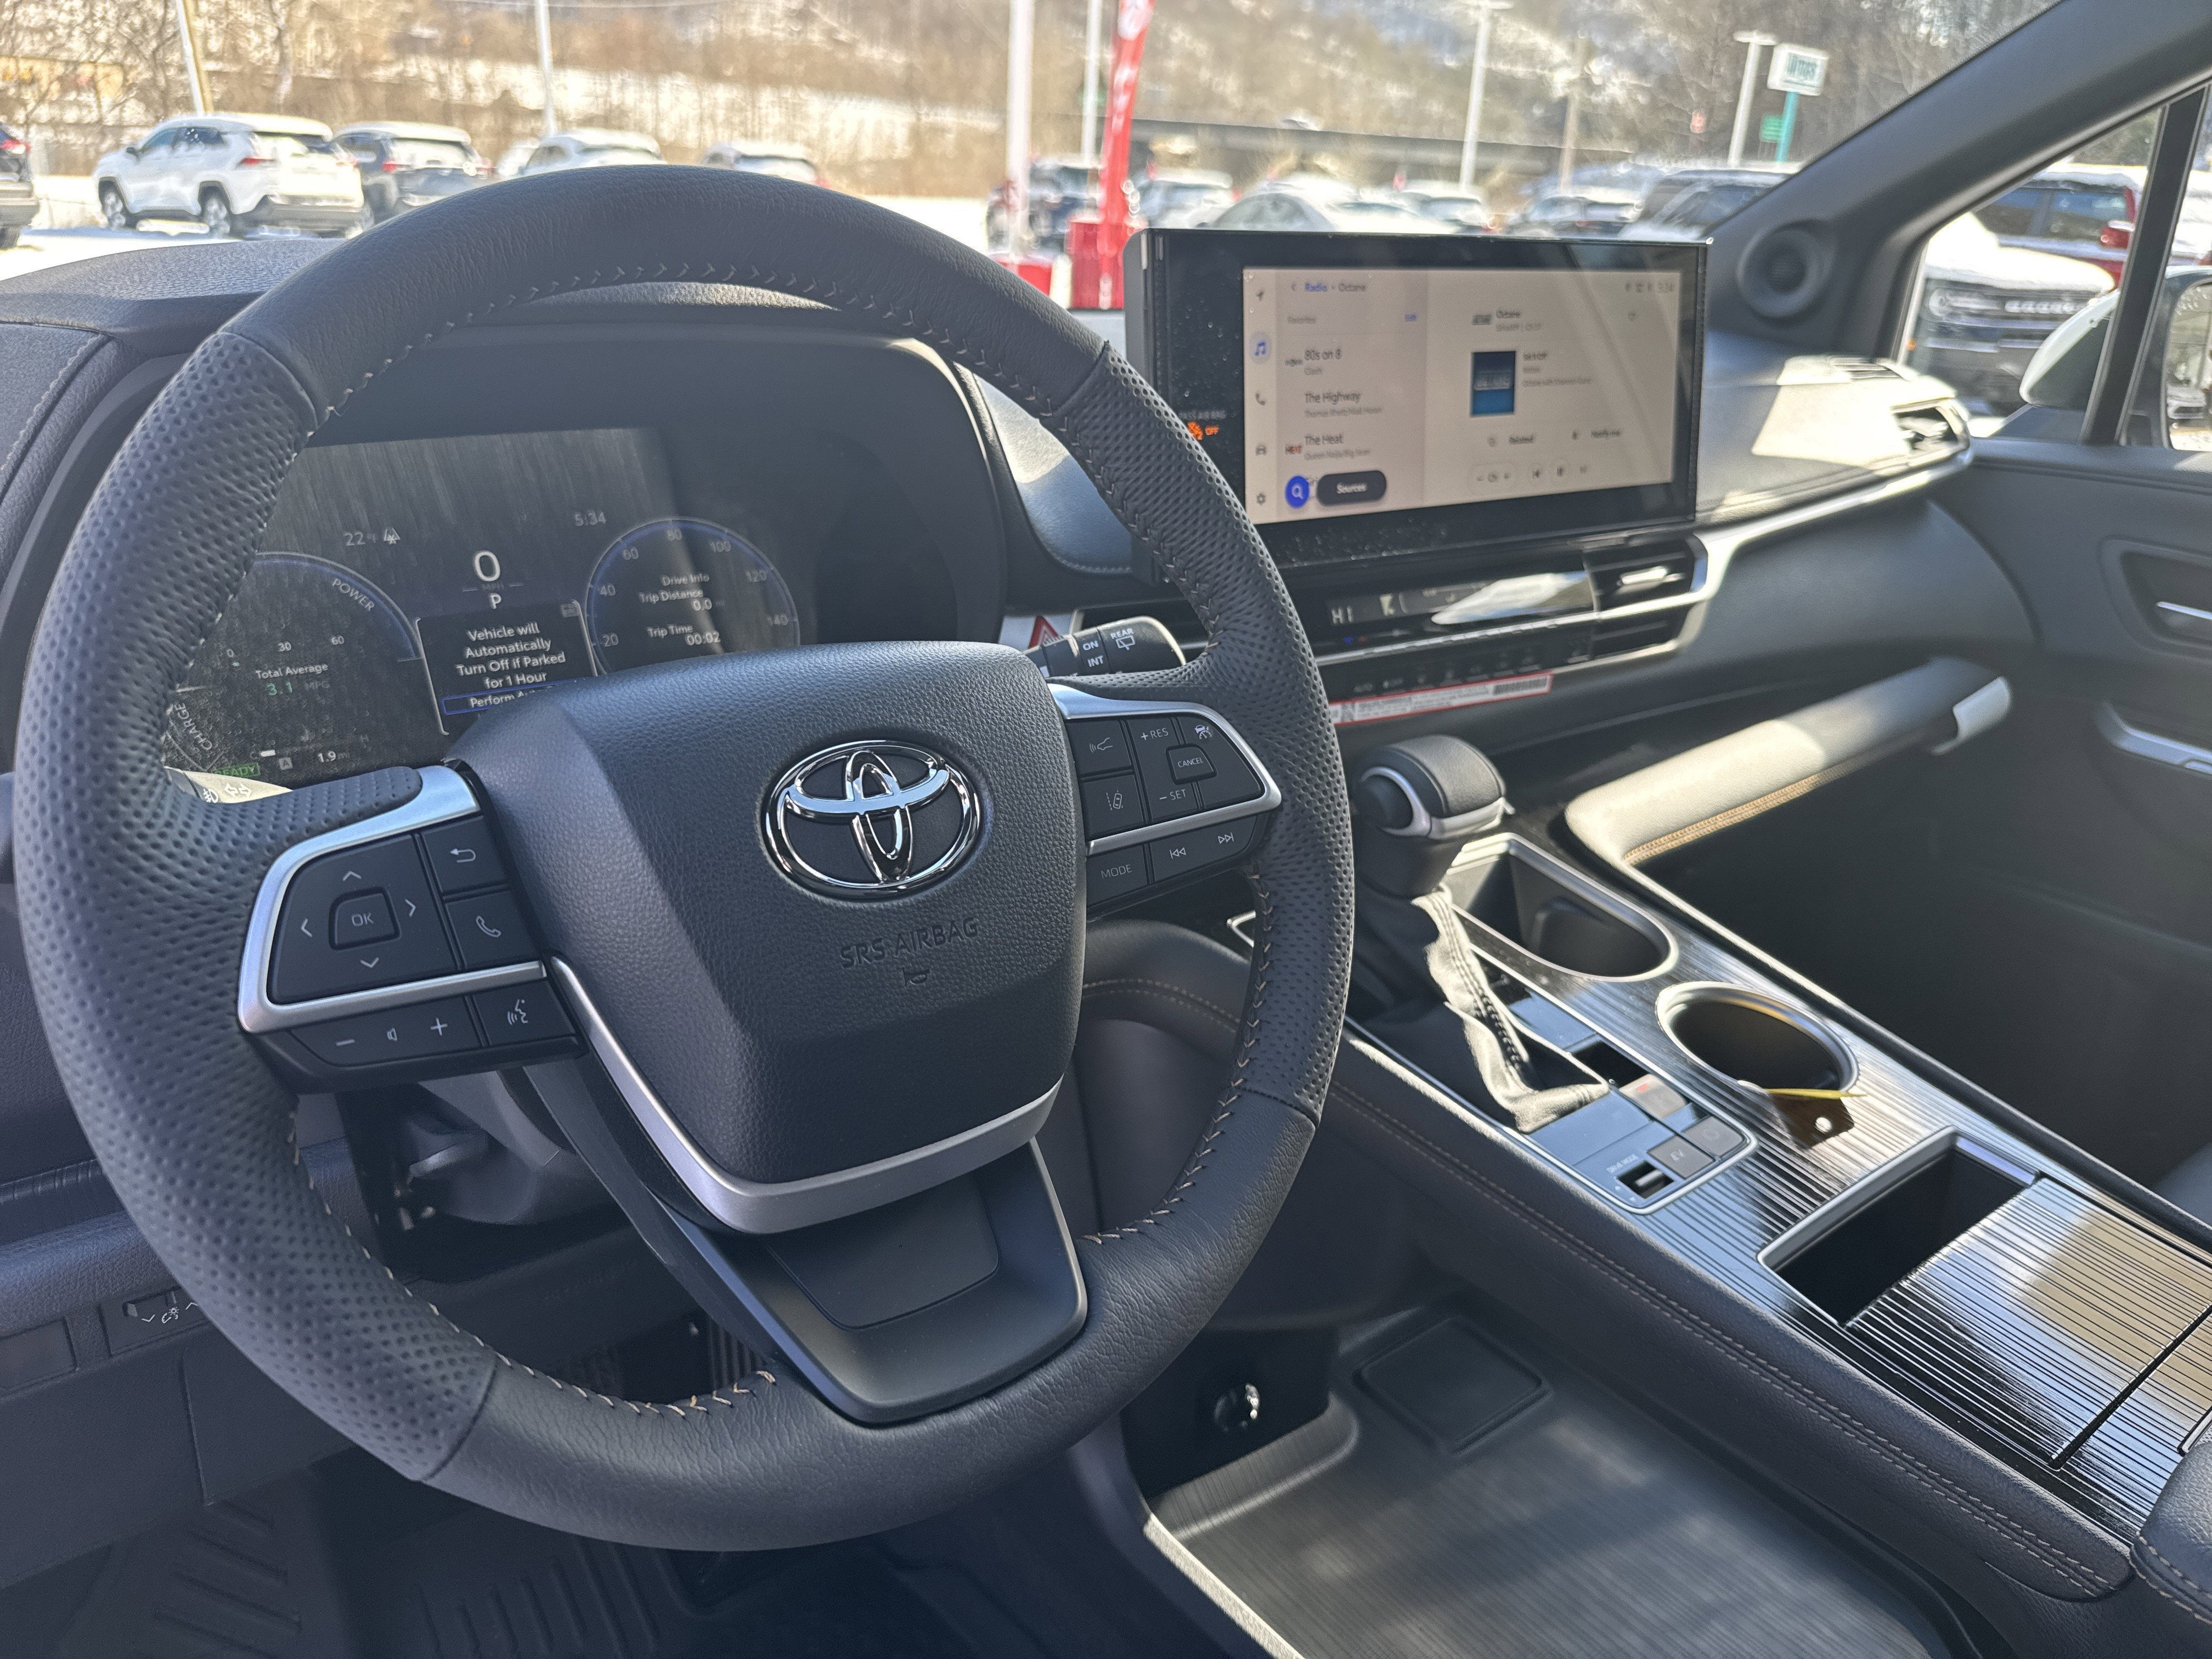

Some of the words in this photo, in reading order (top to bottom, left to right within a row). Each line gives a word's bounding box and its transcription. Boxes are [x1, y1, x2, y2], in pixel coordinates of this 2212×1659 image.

[1338, 282, 1366, 292] Octane
[1335, 347, 1342, 360] 8
[1305, 391, 1321, 403] The
[1322, 390, 1362, 405] Highway
[1305, 434, 1320, 446] The
[1321, 433, 1344, 445] Heat
[1336, 482, 1368, 494] Sources
[667, 528, 682, 541] 80
[710, 540, 732, 552] 100
[622, 546, 639, 561] 60
[662, 574, 688, 586] Drive
[689, 573, 710, 584] Info
[746, 569, 767, 583] 120
[332, 578, 375, 612] POWER
[599, 583, 616, 596] 40
[638, 591, 659, 604] Trip
[659, 589, 704, 602] Distance
[490, 592, 502, 610] P
[692, 597, 713, 611] 0.0
[768, 613, 788, 627] 140
[467, 626, 515, 642] Vehicle
[516, 620, 540, 636] will
[646, 627, 668, 639] Trip
[668, 624, 693, 635] Time
[685, 630, 721, 646] 00:02
[1110, 628, 1135, 640] REAR
[278, 641, 292, 652] 30
[330, 635, 345, 646] 60
[602, 633, 619, 647] 20
[1082, 640, 1099, 651] ON
[465, 636, 551, 659] Automatically
[455, 663, 487, 676] Turn
[488, 658, 510, 672] Off
[512, 658, 521, 669] if
[522, 650, 567, 669] Parked
[1087, 655, 1104, 668] INT
[255, 667, 283, 680] Total
[285, 663, 329, 675] Average
[484, 676, 504, 690] for
[505, 675, 513, 687] 1
[515, 672, 548, 686] Hour
[266, 681, 293, 696] 3.1
[469, 693, 515, 708] Perform
[174, 703, 212, 750] CHARGE
[318, 751, 336, 763] 1.9
[1177, 757, 1204, 768] CANCEL
[1101, 864, 1132, 879] MODE
[351, 912, 375, 927] OK
[840, 938, 886, 969] SRS
[895, 917, 979, 956] AIRBAG
